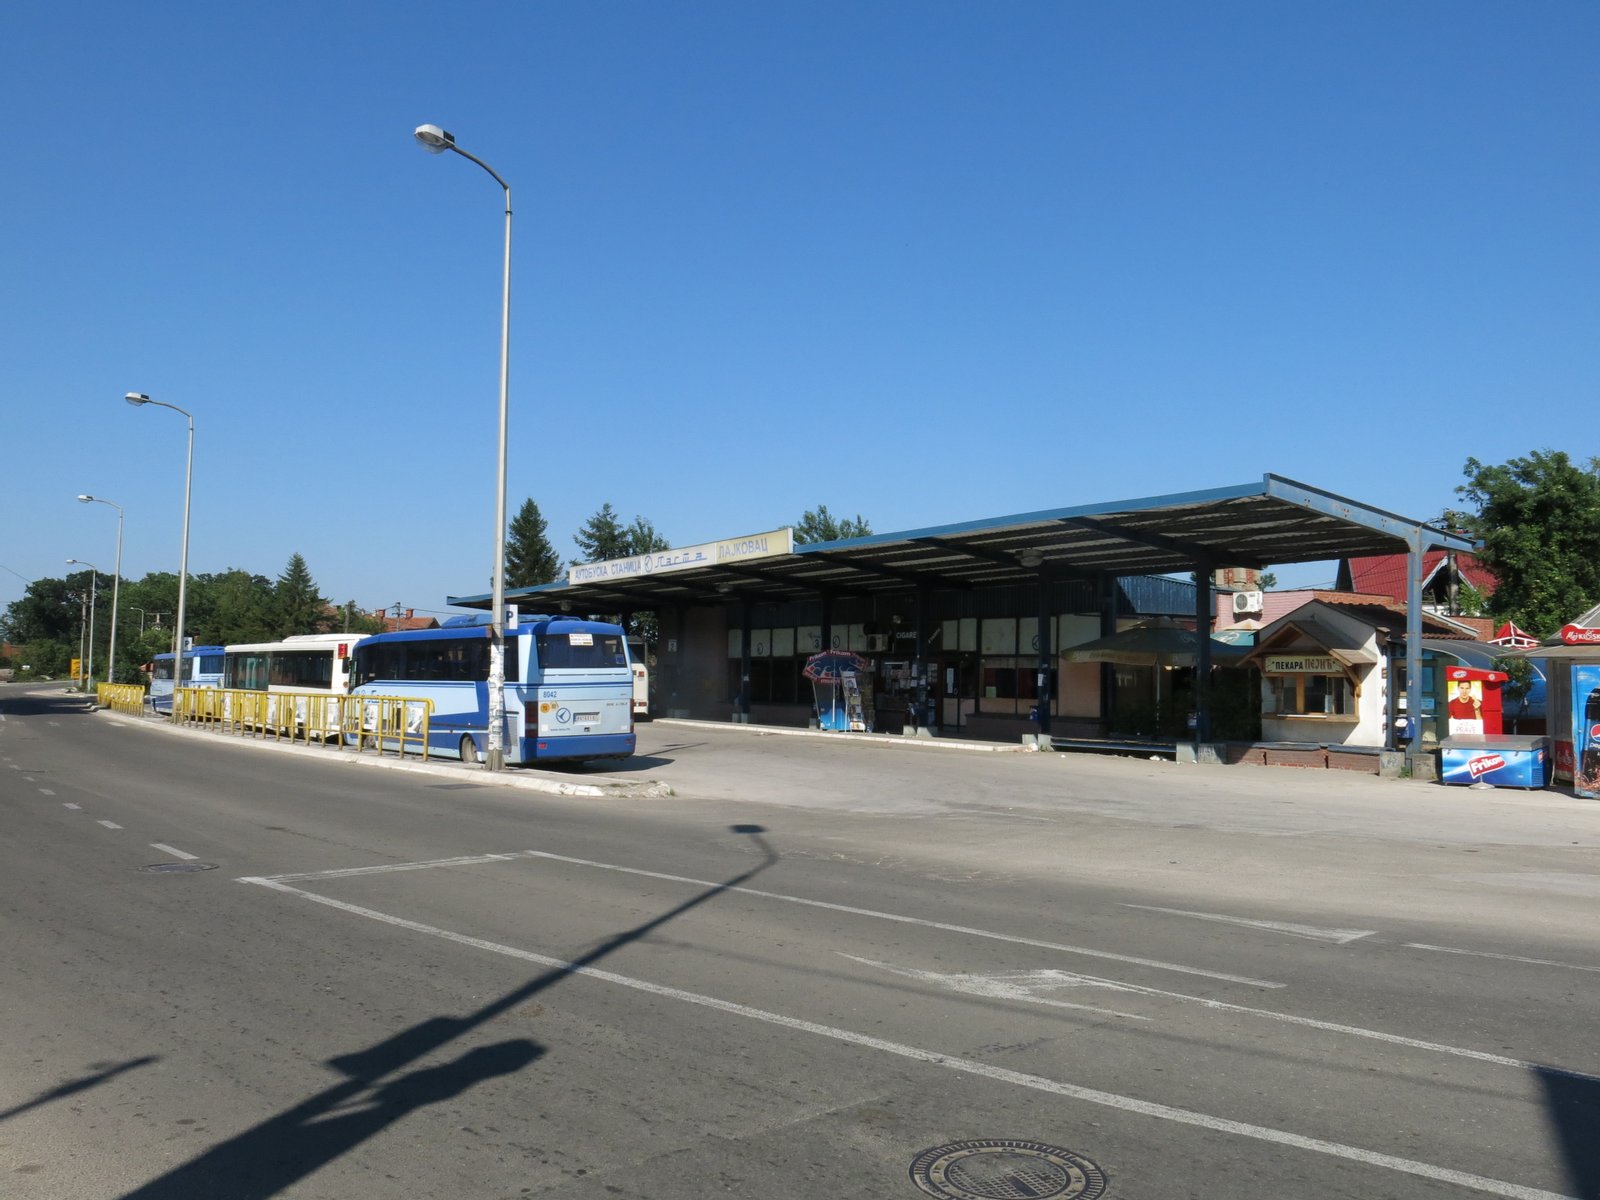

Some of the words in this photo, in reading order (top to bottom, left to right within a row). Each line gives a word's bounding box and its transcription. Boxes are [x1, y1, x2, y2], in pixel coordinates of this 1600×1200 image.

[575, 565, 608, 581] АУТОБУСКА
[611, 560, 641, 575] СТАНИЦА
[719, 537, 768, 558] ЛАЈКОВАЦ
[543, 690, 557, 698] 8042
